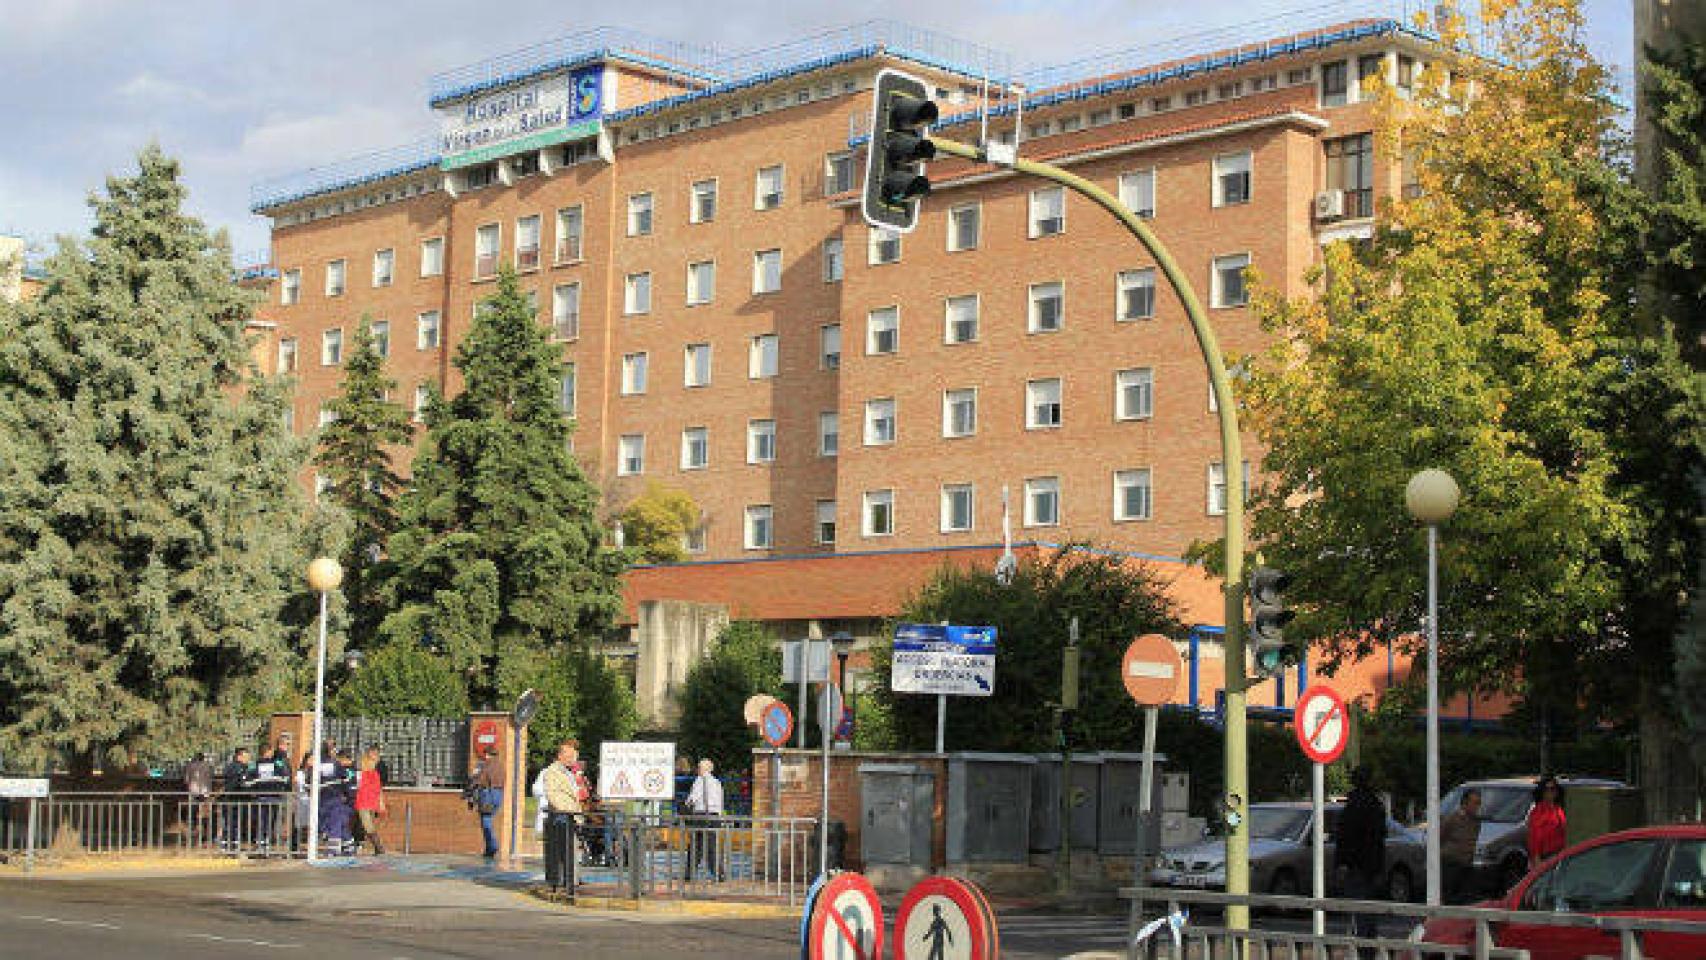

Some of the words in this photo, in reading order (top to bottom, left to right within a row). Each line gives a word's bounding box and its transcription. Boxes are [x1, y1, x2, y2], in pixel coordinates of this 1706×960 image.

[465, 85, 540, 124] Hospital
[442, 125, 491, 151] Virgen
[520, 104, 563, 132] Salud
